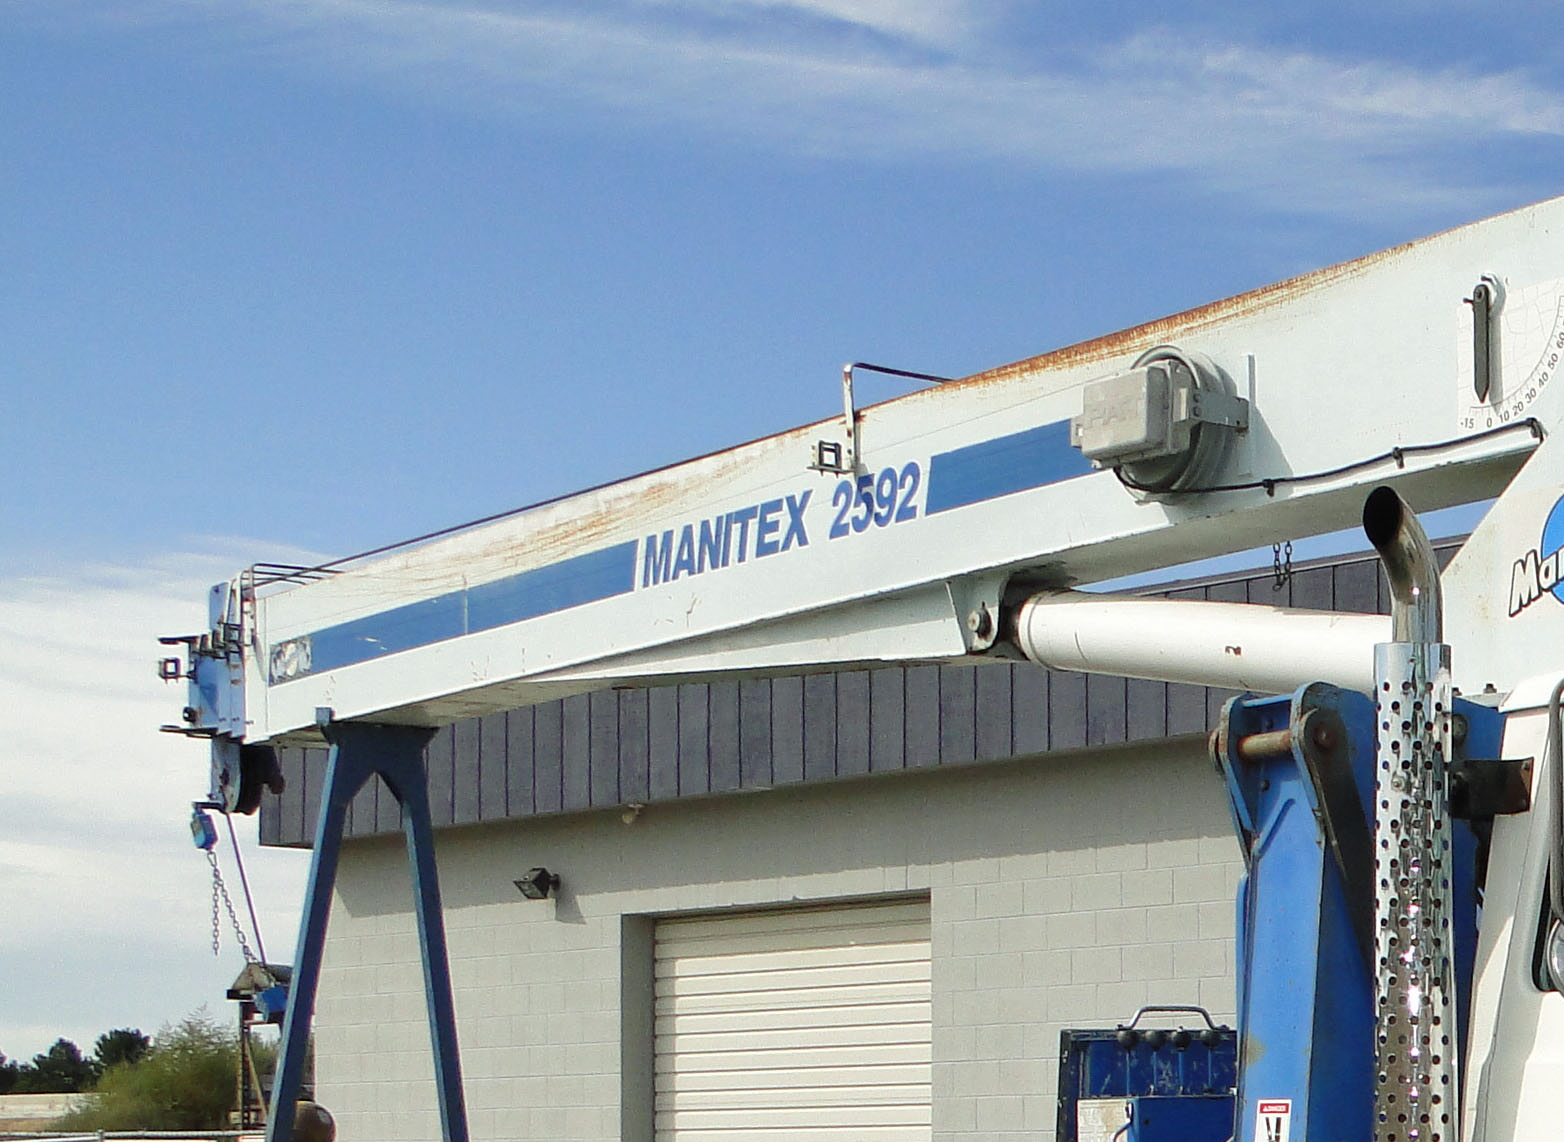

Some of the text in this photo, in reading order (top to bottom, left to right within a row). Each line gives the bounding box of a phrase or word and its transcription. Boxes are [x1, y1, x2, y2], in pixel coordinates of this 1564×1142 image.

[1499, 410, 1511, 423] 10
[1512, 401, 1525, 416] 20
[1525, 388, 1537, 403] 30
[1538, 372, 1549, 388] 40
[1547, 353, 1559, 370] 50
[643, 461, 922, 588] MANITEX 2592
